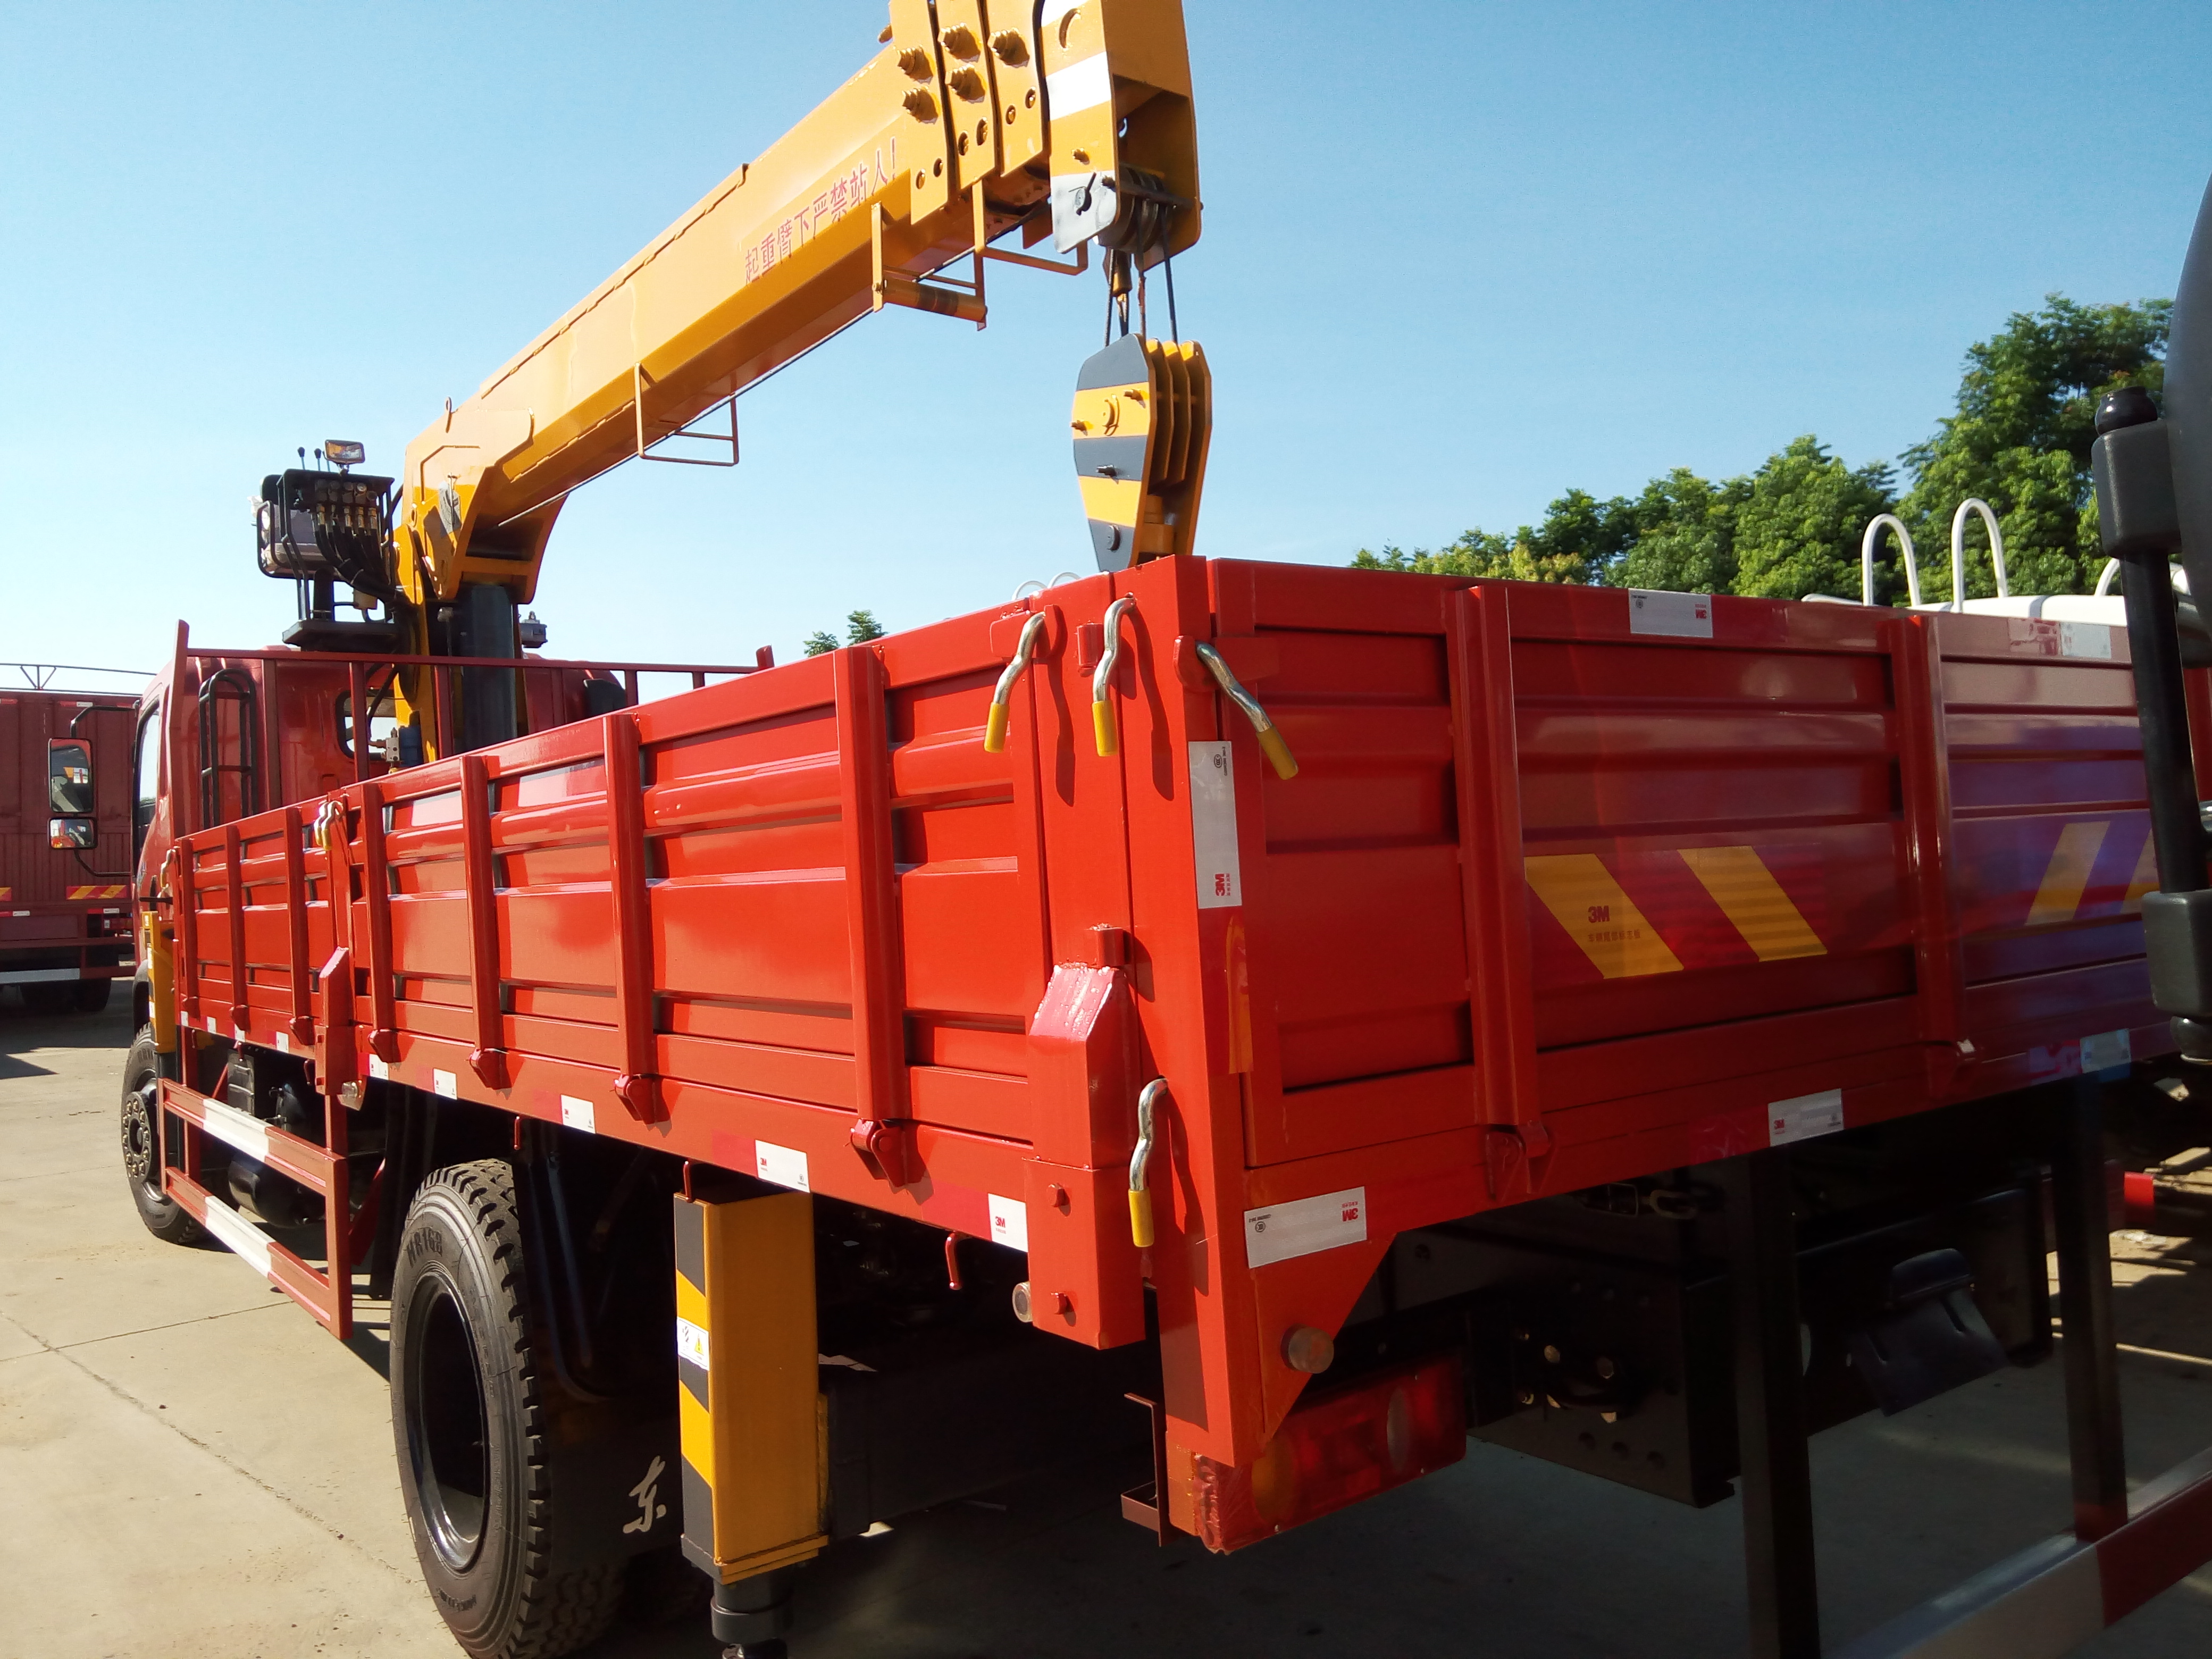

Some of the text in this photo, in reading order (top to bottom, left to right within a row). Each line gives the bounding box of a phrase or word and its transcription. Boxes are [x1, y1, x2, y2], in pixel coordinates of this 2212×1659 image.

[1214, 873, 1226, 896] 3M
[1588, 905, 1610, 923] 3M
[995, 1216, 1006, 1228] 3M
[1342, 1208, 1359, 1222] 3M
